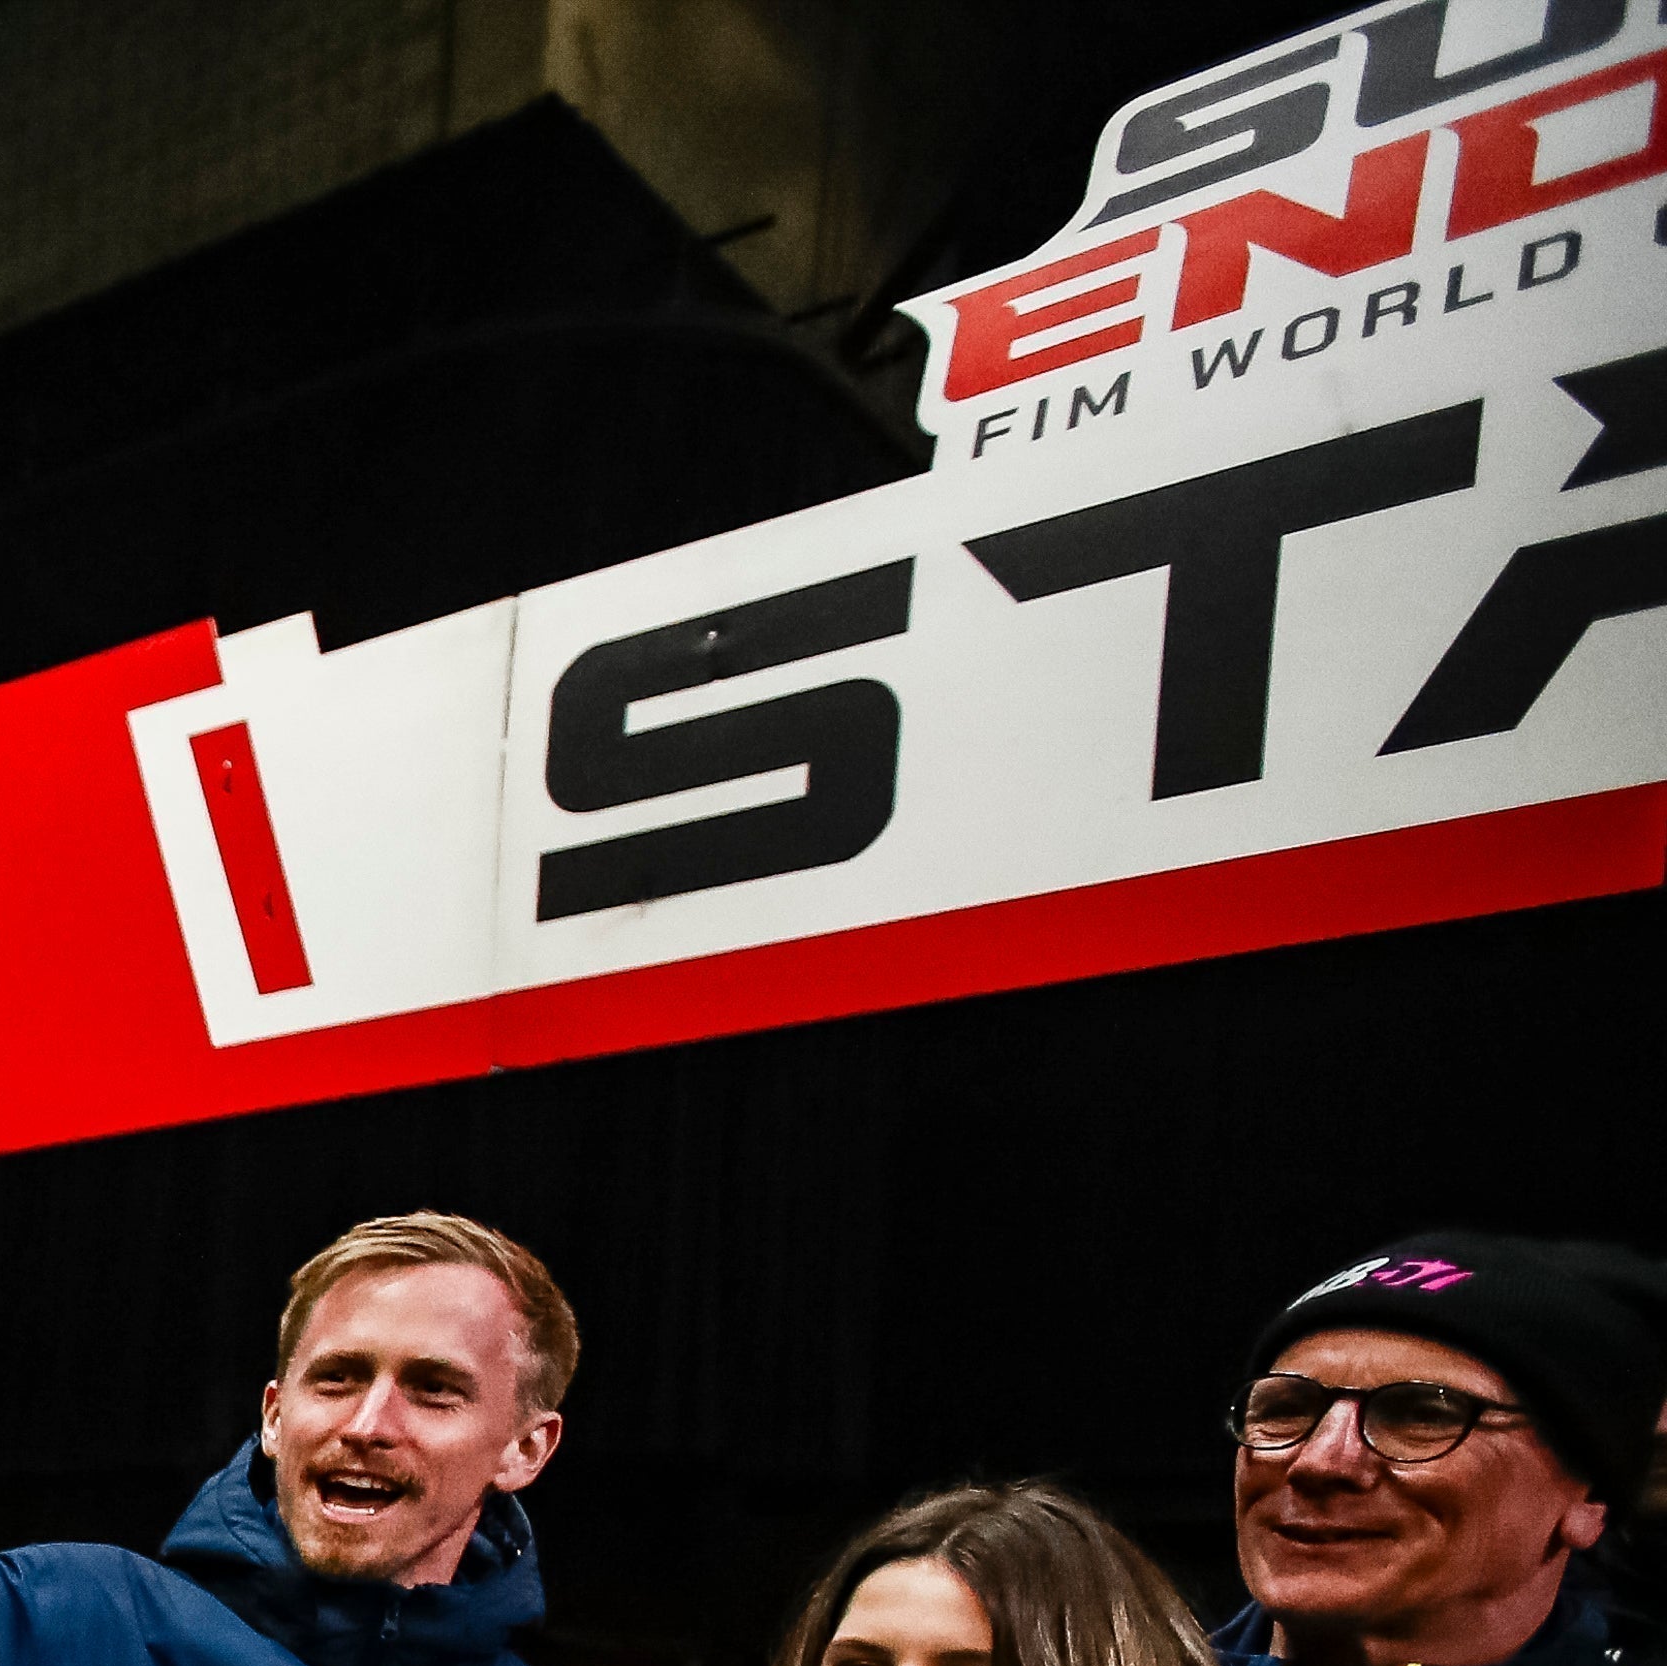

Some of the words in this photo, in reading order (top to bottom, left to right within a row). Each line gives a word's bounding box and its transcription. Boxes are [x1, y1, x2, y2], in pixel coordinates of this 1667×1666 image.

[942, 49, 1667, 403] END
[1078, 0, 1667, 233] SU
[969, 371, 1133, 460] FIM
[1191, 231, 1584, 392] WORLD
[536, 350, 1667, 922] STA
